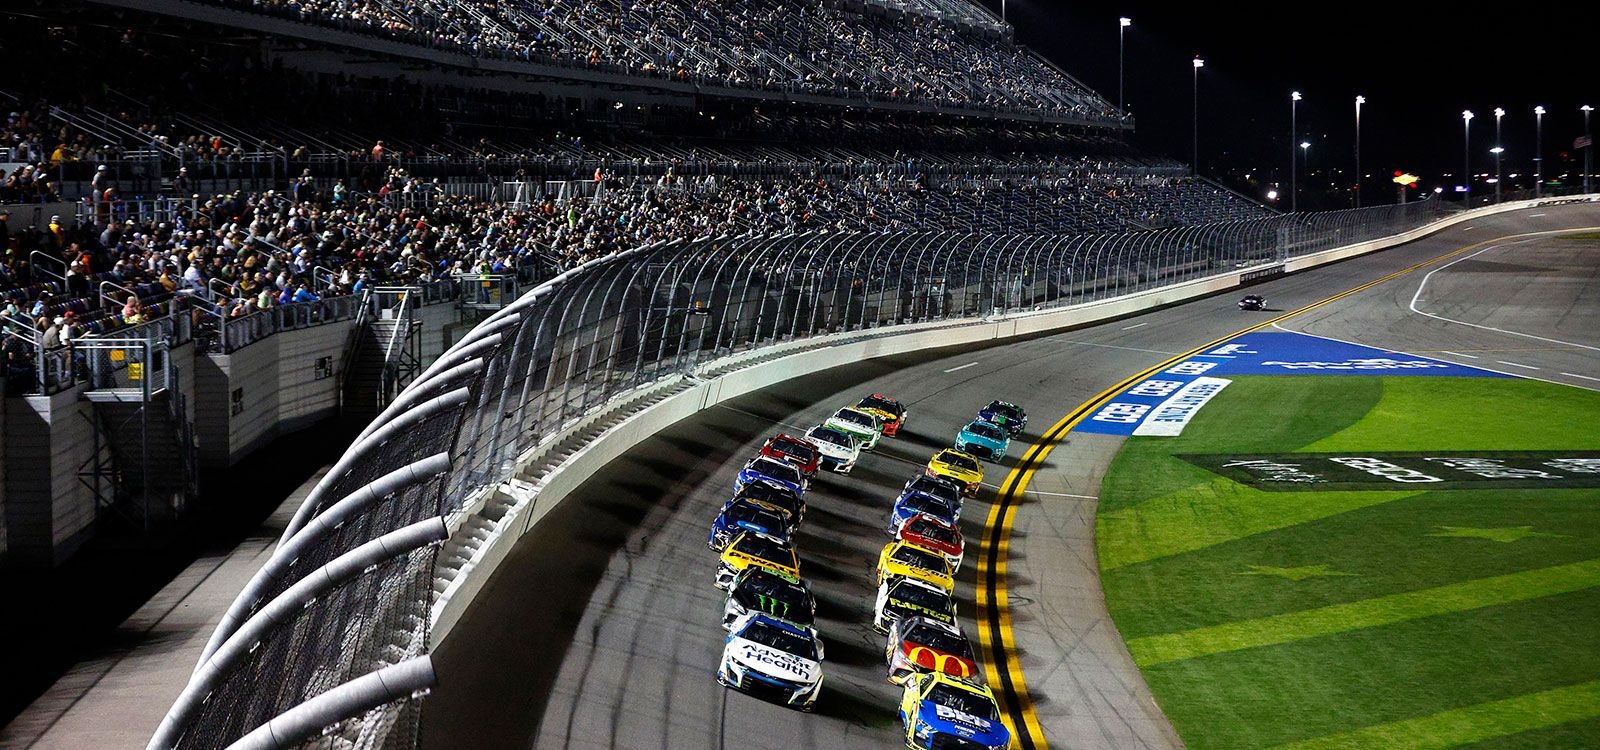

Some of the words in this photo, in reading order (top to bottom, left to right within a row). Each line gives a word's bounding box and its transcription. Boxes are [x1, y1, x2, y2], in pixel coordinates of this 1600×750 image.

[1153, 406, 1193, 423] ZONE
[889, 597, 952, 623] RAPTOR
[743, 643, 811, 671] Advent
[746, 652, 810, 681] Health
